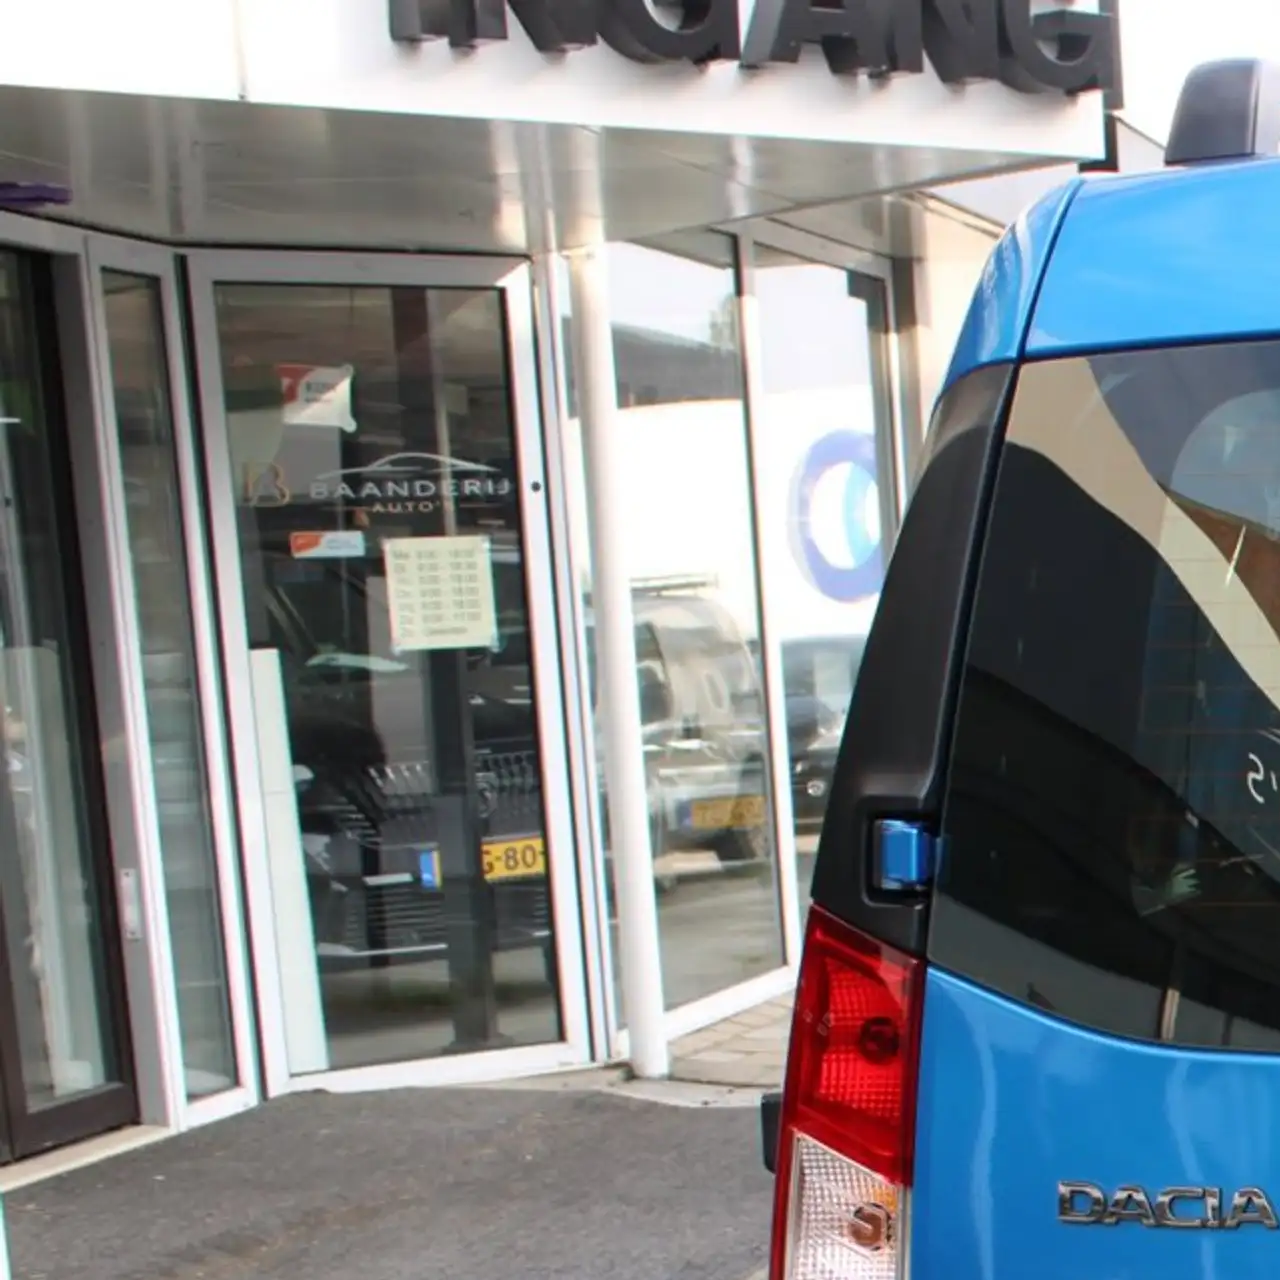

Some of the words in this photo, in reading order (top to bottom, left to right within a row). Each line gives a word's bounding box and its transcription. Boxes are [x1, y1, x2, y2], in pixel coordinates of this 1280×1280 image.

[309, 479, 511, 500] BAANDERIJ
[372, 500, 455, 514] AUTO'
[1057, 1180, 1280, 1229] DACIA
